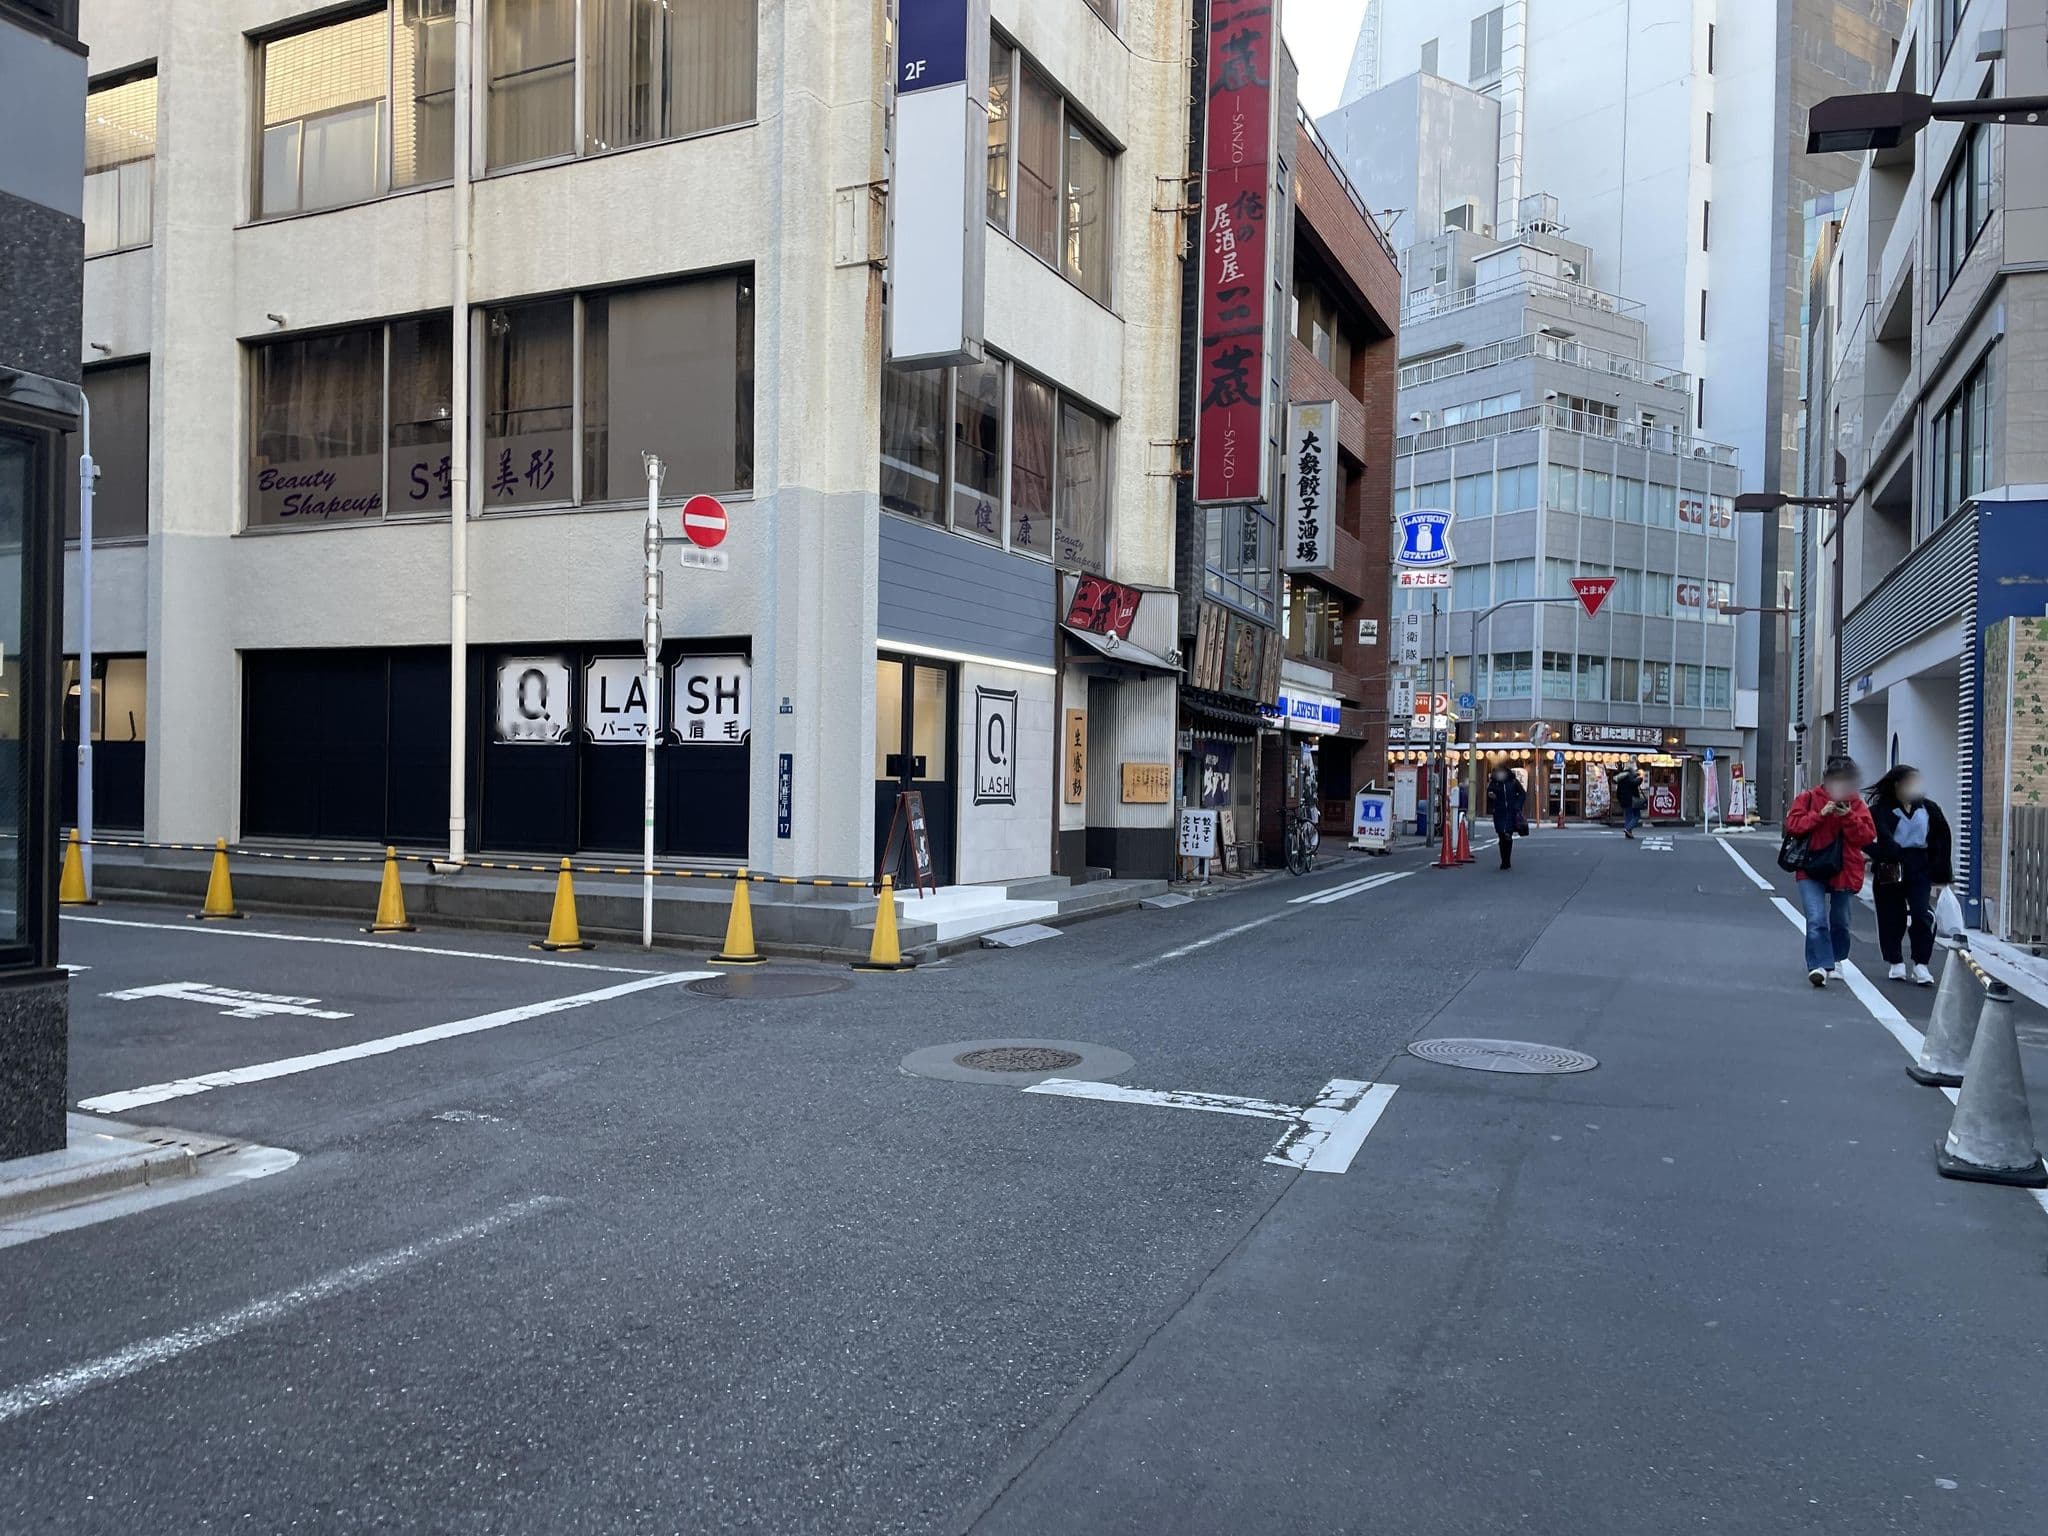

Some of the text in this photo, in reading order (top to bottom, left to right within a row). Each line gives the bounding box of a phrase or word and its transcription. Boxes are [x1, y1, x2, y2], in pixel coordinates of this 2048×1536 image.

[904, 59, 927, 81] 2F
[1231, 113, 1245, 164] SANZO
[1230, 190, 1264, 242] 俺の
[1209, 202, 1245, 285] 居酒屋
[1223, 429, 1236, 480] SANZO
[258, 468, 336, 492] Beauty
[491, 448, 557, 496] 美形
[279, 492, 383, 519] Shapeup
[1296, 430, 1323, 563] 大衆餃子酒場
[974, 500, 1034, 546] 健康
[1403, 514, 1447, 527] LAWSON
[1054, 527, 1085, 550] Beauty
[1063, 548, 1102, 571] Shapeup
[1402, 548, 1446, 560] STATION
[1579, 585, 1607, 596] 止まれ
[1405, 614, 1419, 661] 自衛隊
[518, 670, 551, 721] Q
[1291, 699, 1320, 720] LAWSON
[981, 776, 1011, 793] LASH
[779, 823, 790, 833] 17
